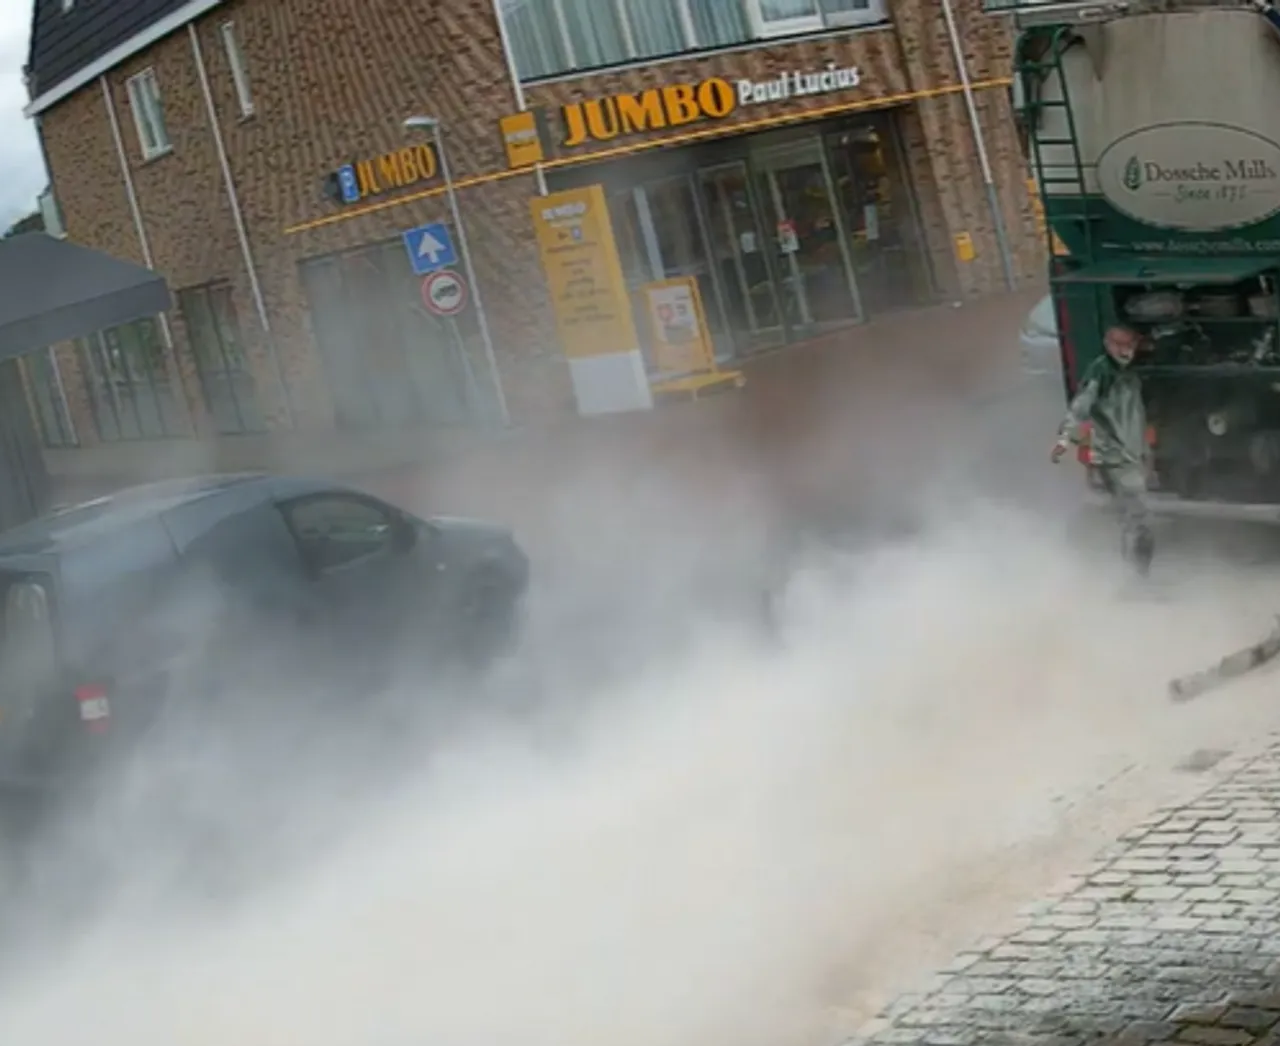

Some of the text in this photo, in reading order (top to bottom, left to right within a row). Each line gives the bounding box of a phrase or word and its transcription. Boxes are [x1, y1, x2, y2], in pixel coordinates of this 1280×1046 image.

[563, 76, 735, 147] JUMBO
[737, 71, 788, 106] Paul
[793, 63, 860, 97] Lucius
[355, 143, 437, 197] JUMBO
[1144, 160, 1277, 182] Dossche Mills
